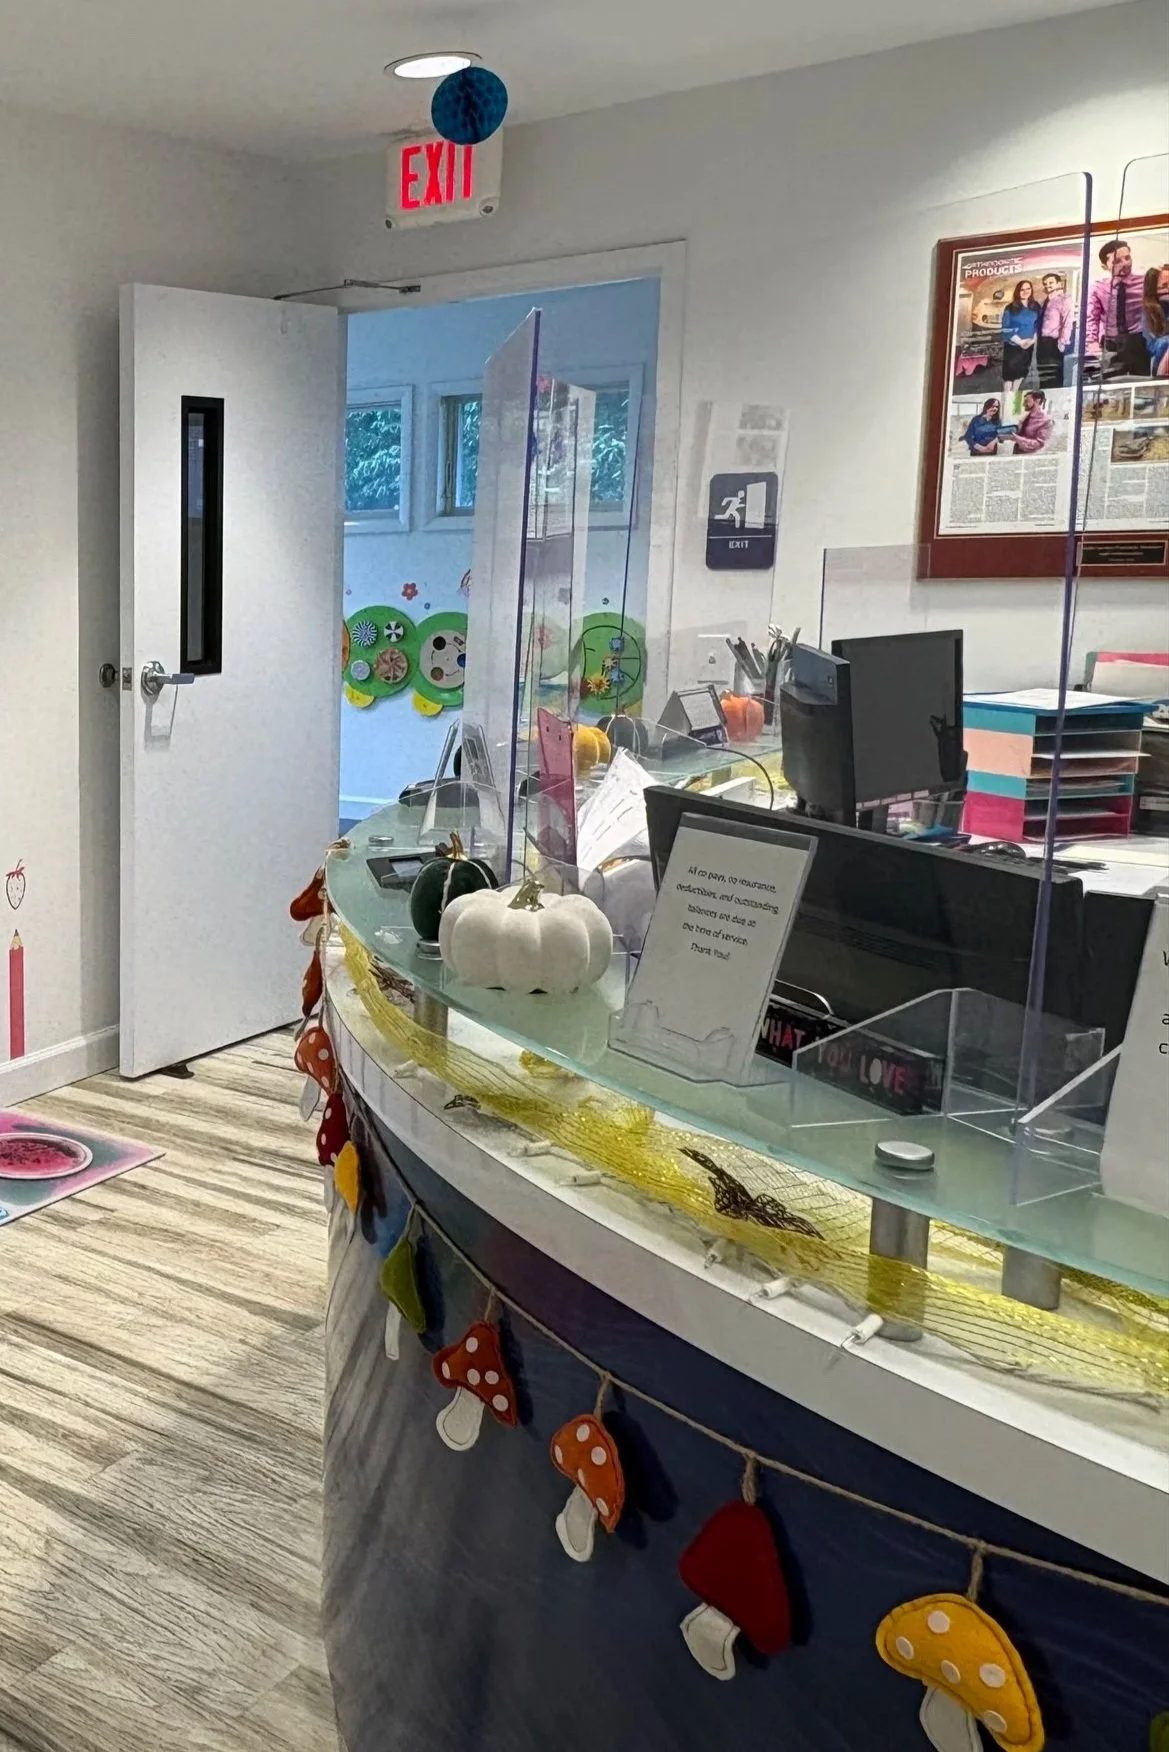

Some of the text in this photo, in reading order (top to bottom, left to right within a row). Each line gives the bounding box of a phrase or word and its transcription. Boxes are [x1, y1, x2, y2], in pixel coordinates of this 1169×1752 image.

[965, 264, 1022, 279] PRODUCTS
[728, 540, 749, 549] EXIT
[859, 1054, 907, 1096] LOVE
